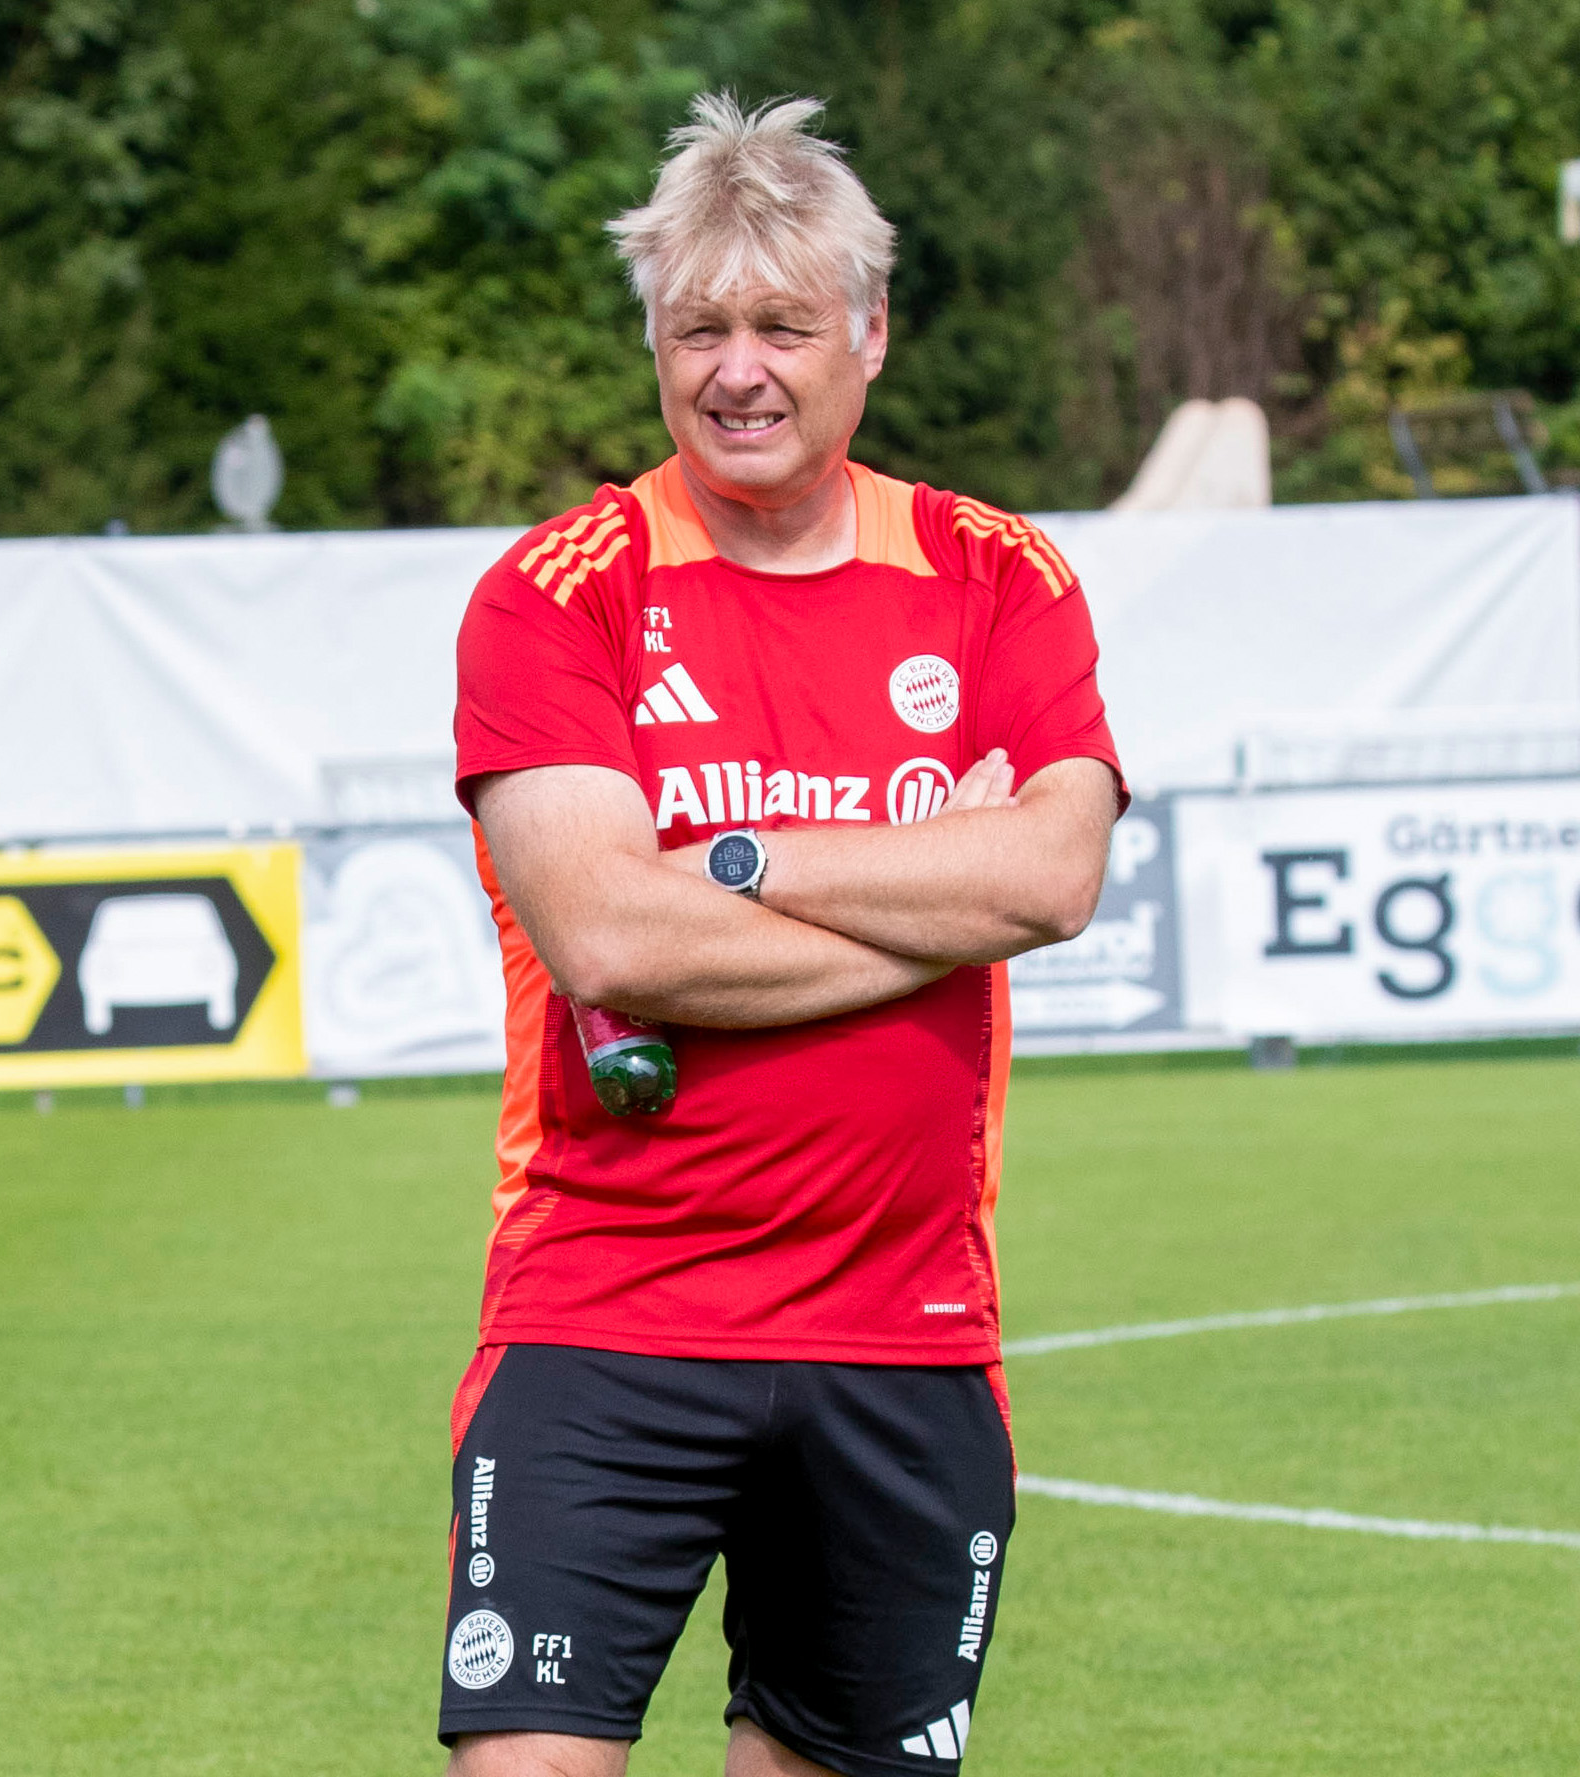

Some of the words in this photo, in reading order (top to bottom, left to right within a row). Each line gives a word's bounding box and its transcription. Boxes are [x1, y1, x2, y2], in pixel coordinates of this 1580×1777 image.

[643, 606, 673, 628] F1
[643, 630, 672, 653] KL
[908, 662, 955, 688] BAYERN
[655, 760, 871, 830] Allianz
[1261, 846, 1580, 1001] Egg
[471, 1456, 496, 1549] Allianz
[957, 1570, 991, 1663] Allianz
[454, 1627, 467, 1646] FC
[467, 1616, 507, 1643] BAYERN
[532, 1632, 573, 1659] FF1
[536, 1660, 566, 1685] KL
